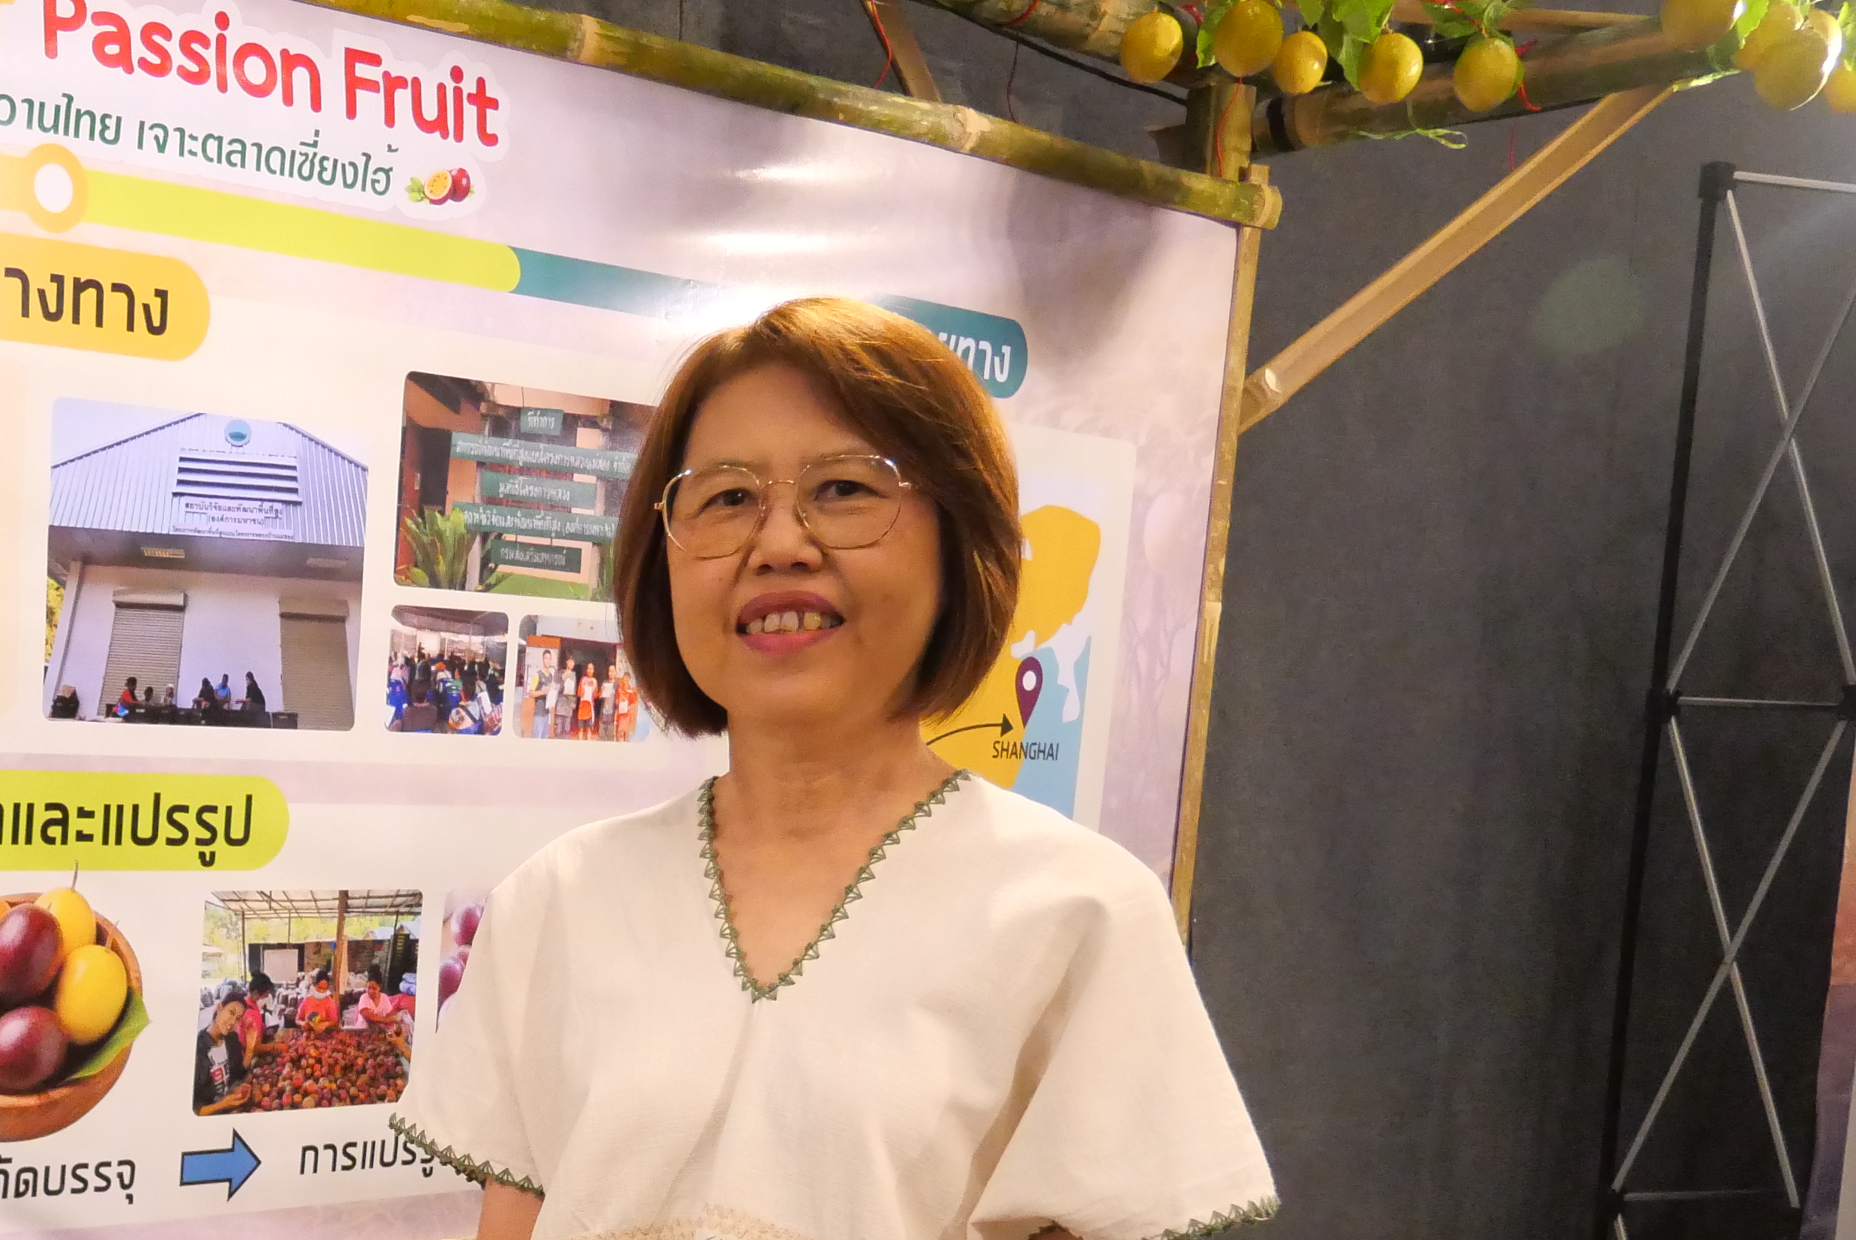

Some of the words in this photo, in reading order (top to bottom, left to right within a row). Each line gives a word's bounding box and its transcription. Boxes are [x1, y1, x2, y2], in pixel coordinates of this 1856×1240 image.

[43, 0, 322, 113] Passion
[344, 47, 500, 147] Fruit
[136, 119, 400, 198] เจาะตลาดเซี่ยงไฮ้
[992, 740, 1059, 761] SHANGHAI
[299, 1134, 435, 1178] การแปรรู
